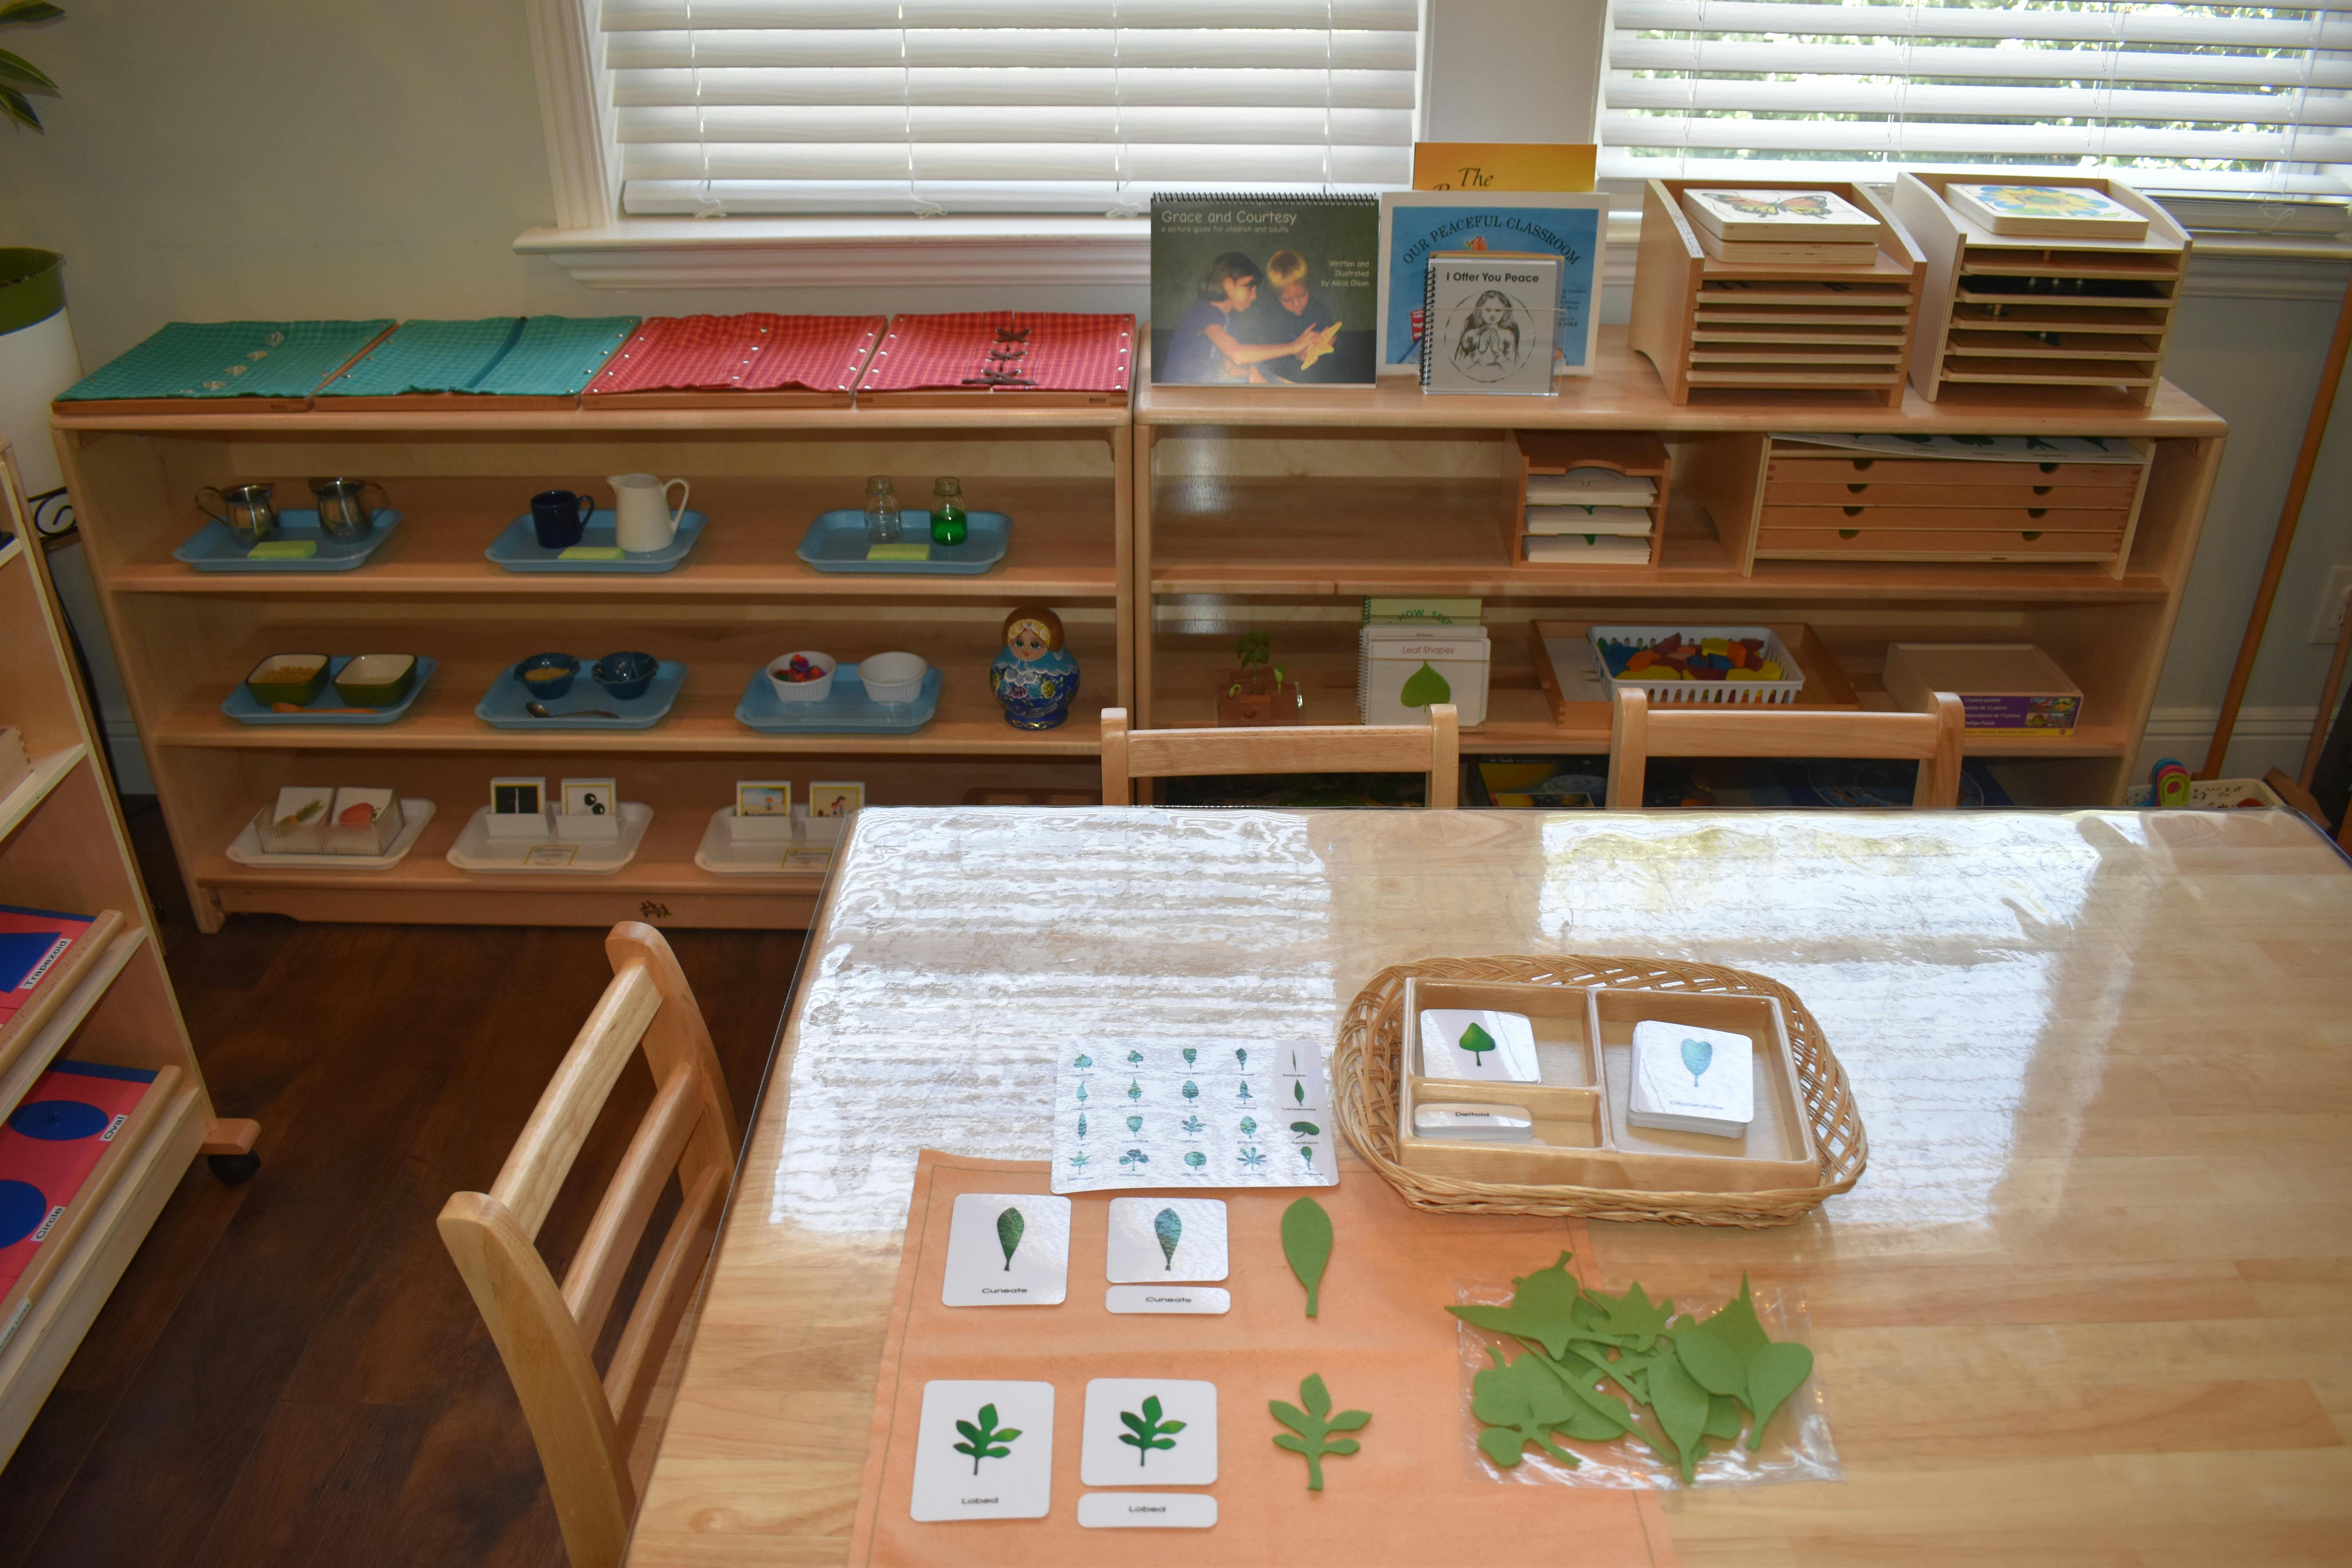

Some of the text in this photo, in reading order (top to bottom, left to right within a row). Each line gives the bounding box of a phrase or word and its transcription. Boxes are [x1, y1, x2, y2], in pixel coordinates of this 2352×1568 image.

[1458, 167, 1494, 187] The
[1162, 210, 1297, 226] Grace and Courtesy
[1403, 215, 1581, 265] OUR PEACEFUL CLASSROOM
[1446, 272, 1539, 282] I Offer You Peace
[1398, 608, 1425, 622] HOW
[1423, 646, 1454, 655] Shapes
[24, 940, 67, 986] Trapezoid
[1670, 1100, 1724, 1110] Obcordate
[104, 1116, 125, 1139] Oval
[36, 1207, 63, 1239] Circle
